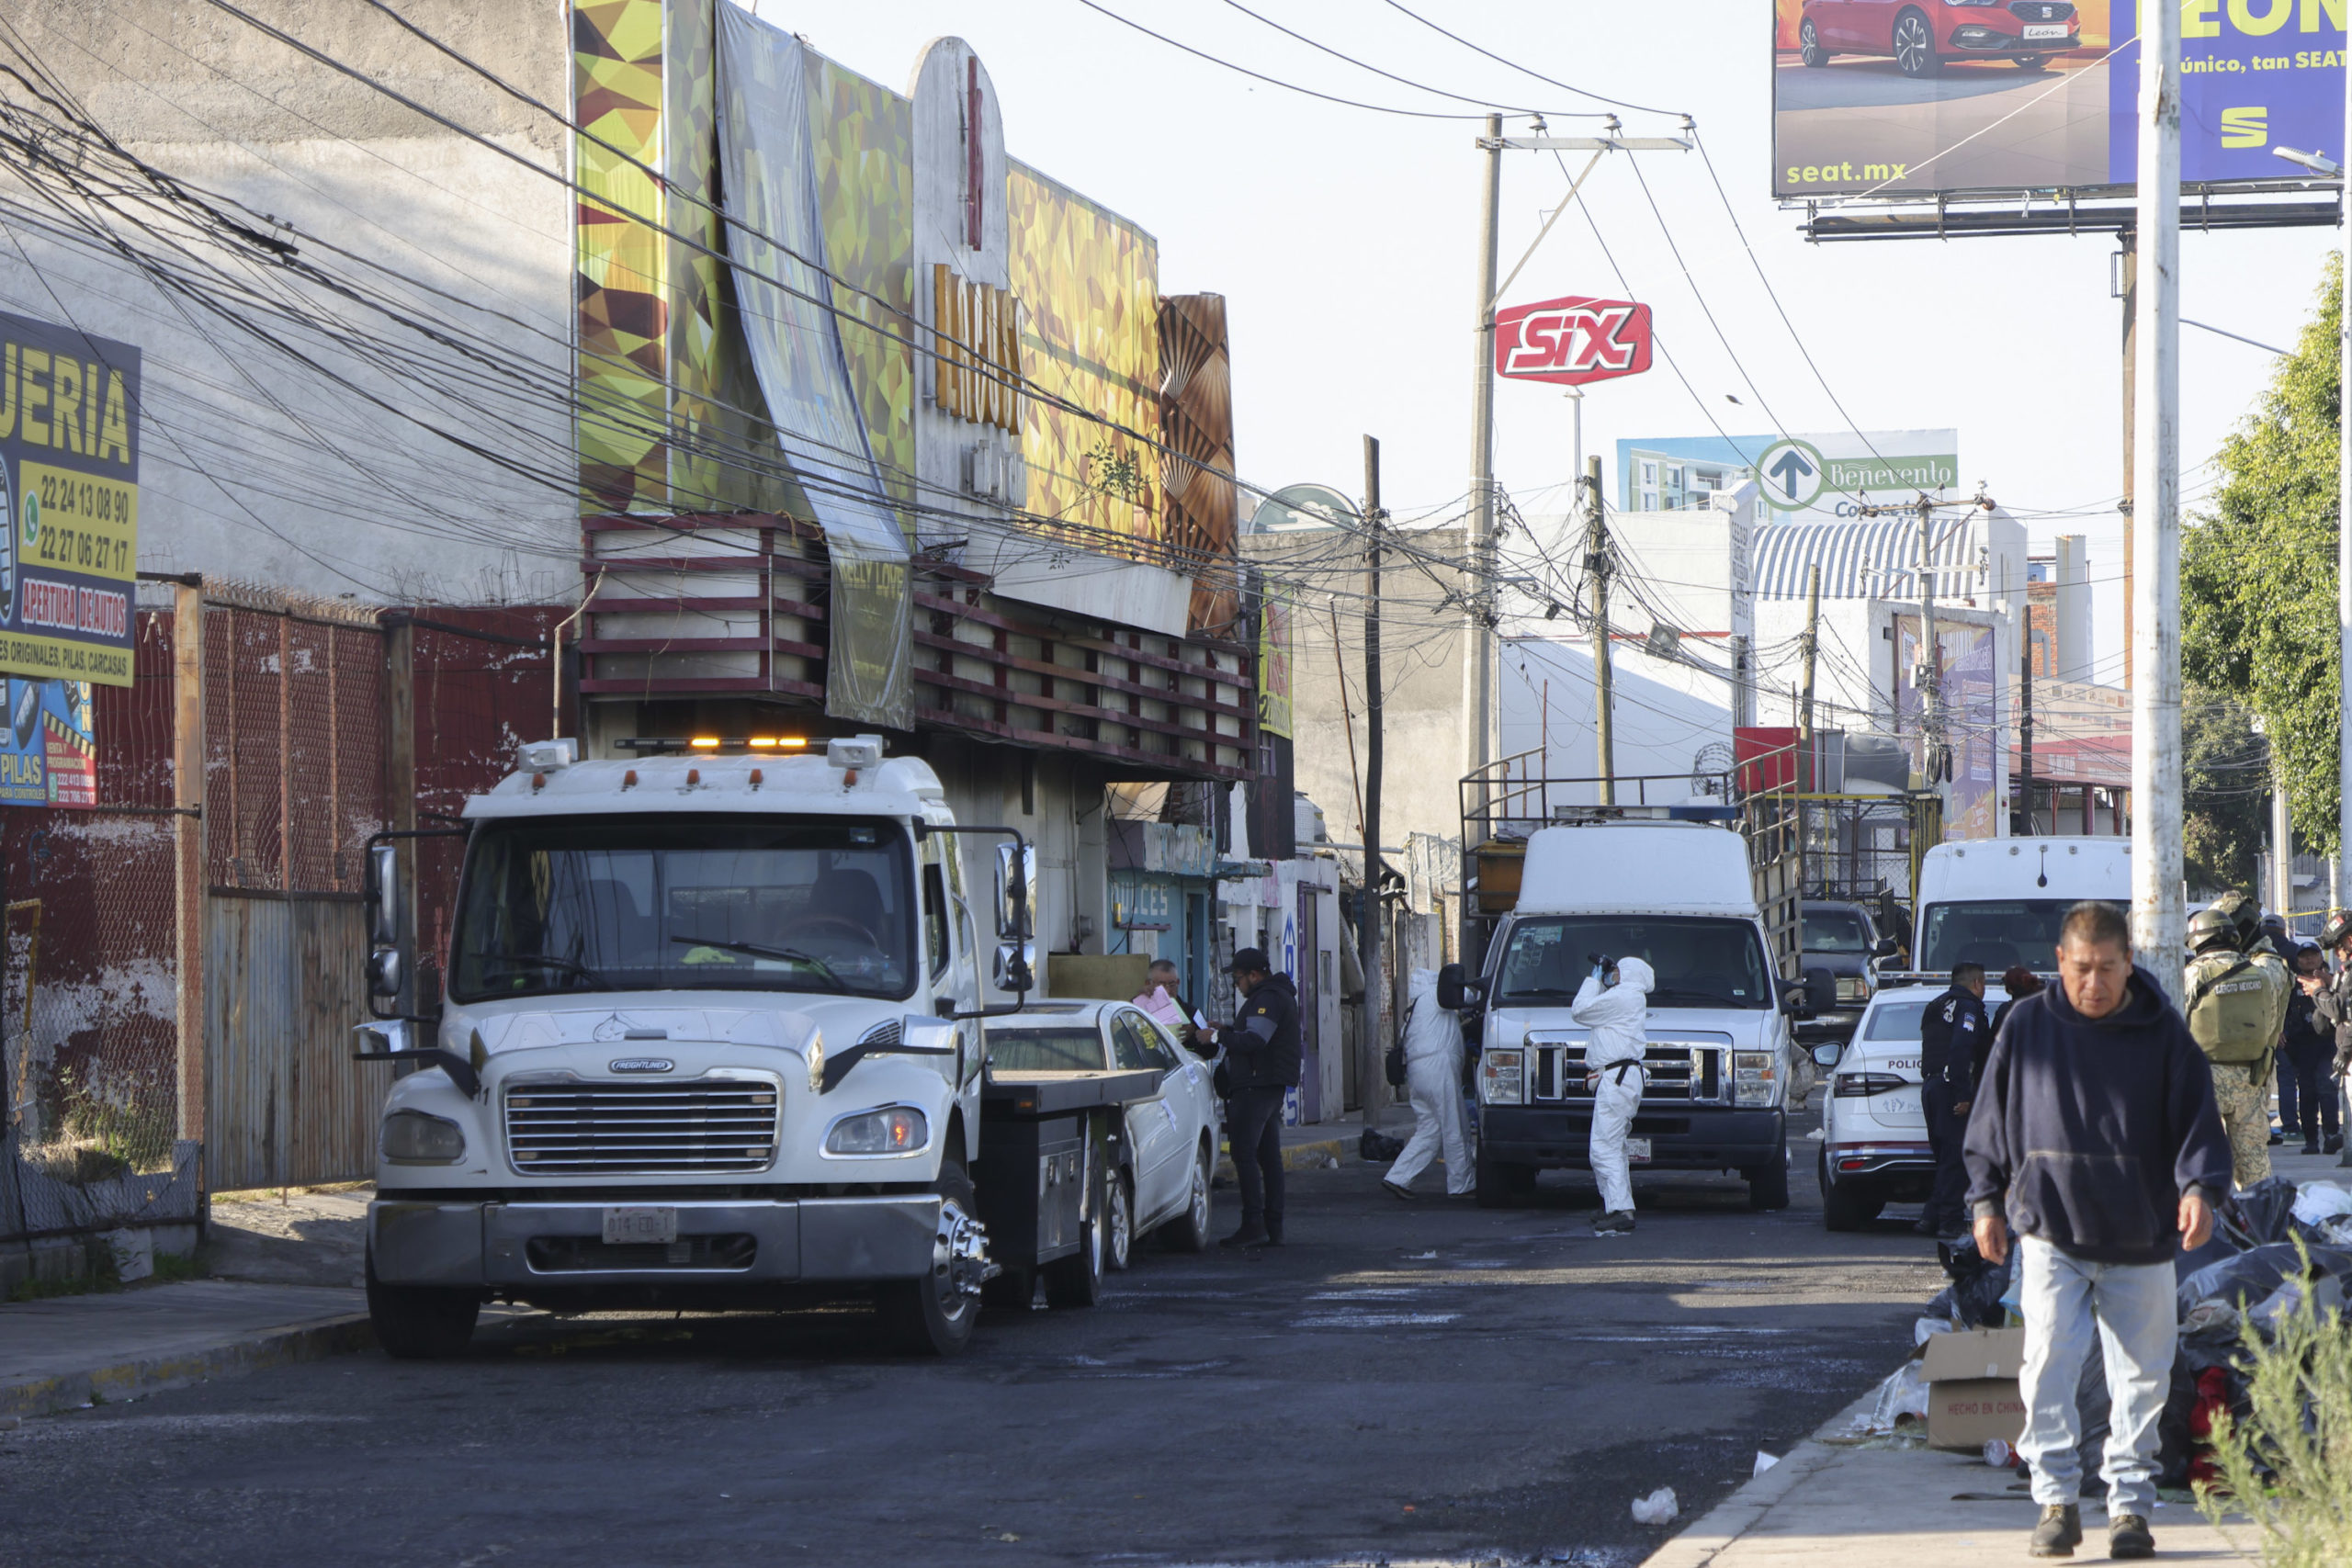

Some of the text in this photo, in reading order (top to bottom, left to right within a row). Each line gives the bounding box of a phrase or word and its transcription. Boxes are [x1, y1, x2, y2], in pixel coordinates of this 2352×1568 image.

[2252, 56, 2290, 71] tan
[2295, 51, 2346, 68] SEAT
[1787, 162, 1906, 183] seat.mx
[1831, 460, 1951, 487] Benevento
[41, 475, 128, 525] 22 24 13 08 90
[40, 525, 128, 572] 22 27 06 27 17
[22, 579, 126, 637] APERTURA DE AUTOS
[10, 641, 60, 671] ORIGINALES,
[63, 648, 86, 673] PILAS,
[88, 652, 127, 676] CARCASAS
[1, 754, 41, 785] PILAS
[57, 773, 68, 785] 222
[15, 788, 45, 800] CONTROLES
[58, 790, 69, 803] 222
[616, 1061, 666, 1069] FREIGHTLINER
[1949, 1404, 1978, 1416] HECHO
[1982, 1403, 1993, 1415] EN
